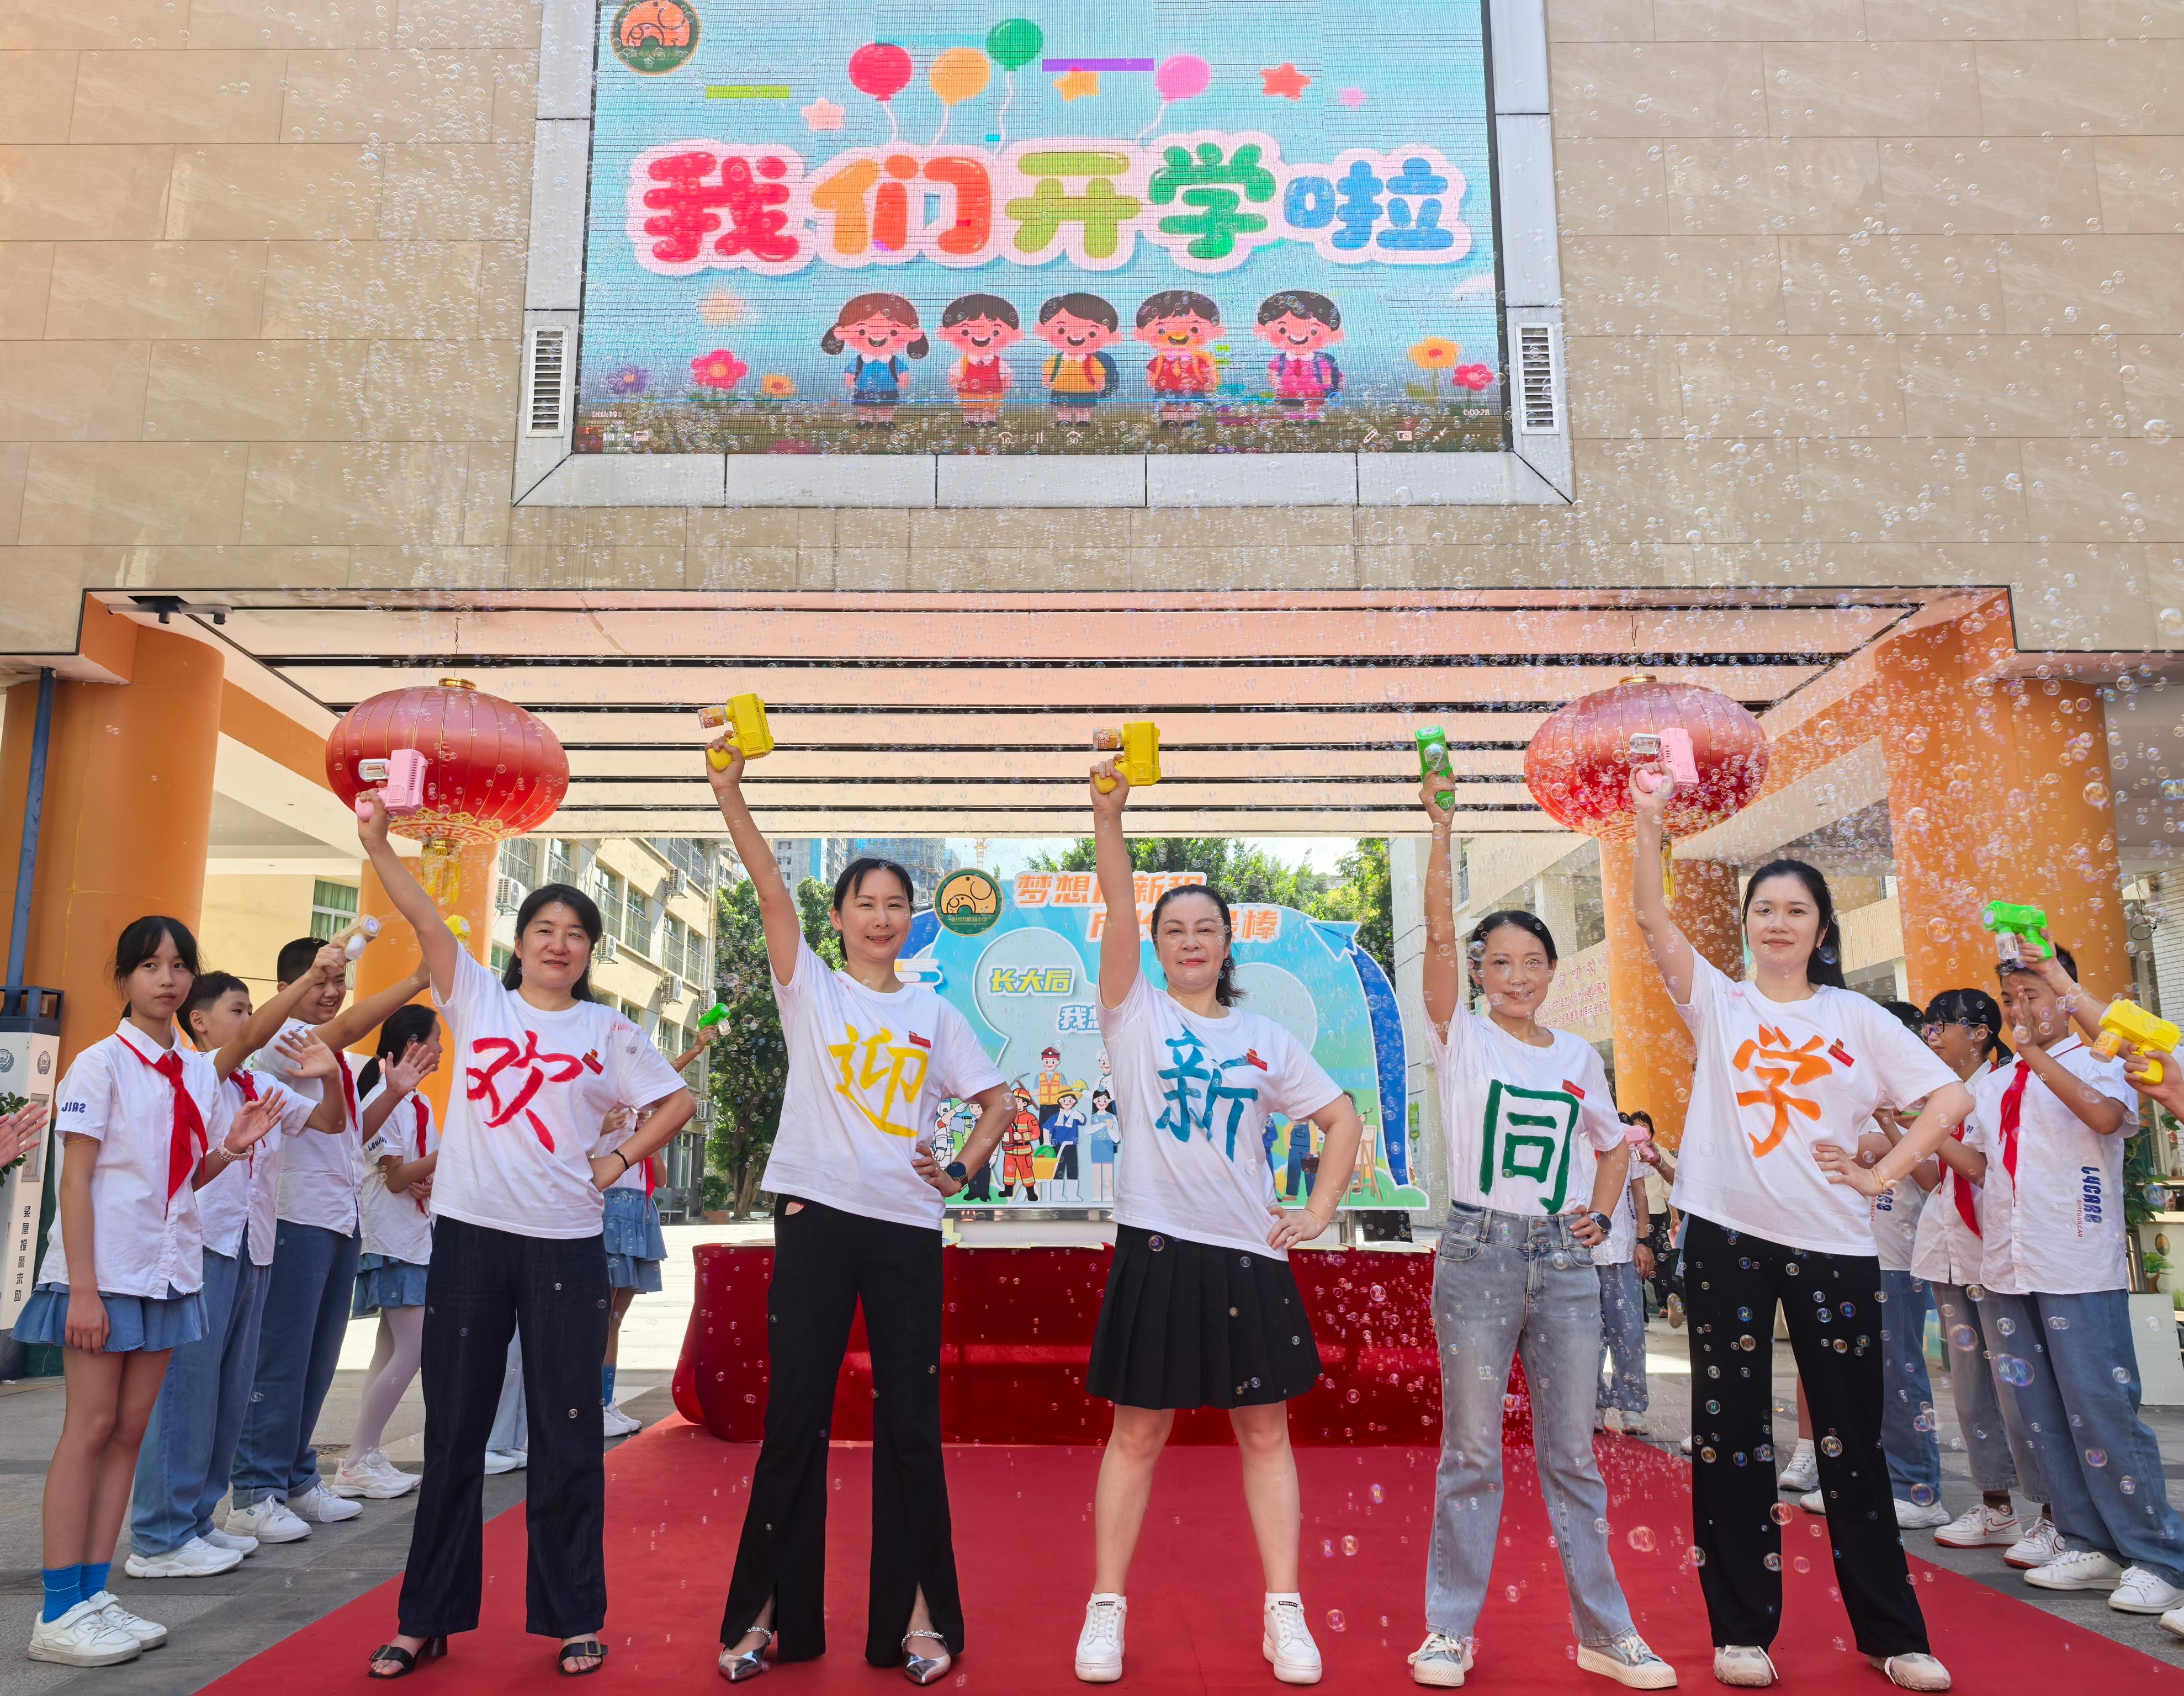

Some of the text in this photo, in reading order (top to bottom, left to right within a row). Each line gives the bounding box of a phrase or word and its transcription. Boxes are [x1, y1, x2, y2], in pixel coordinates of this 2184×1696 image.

[644, 142, 1455, 262] 我们开学啦
[990, 968, 1072, 993] 长大后
[466, 1030, 584, 1154] 欢
[828, 1021, 929, 1138] 迎
[1155, 1024, 1259, 1161] 新
[1732, 1024, 1833, 1158] 学
[1479, 1079, 1579, 1215] 同
[14, 1205, 31, 1302] 紧急报警求助
